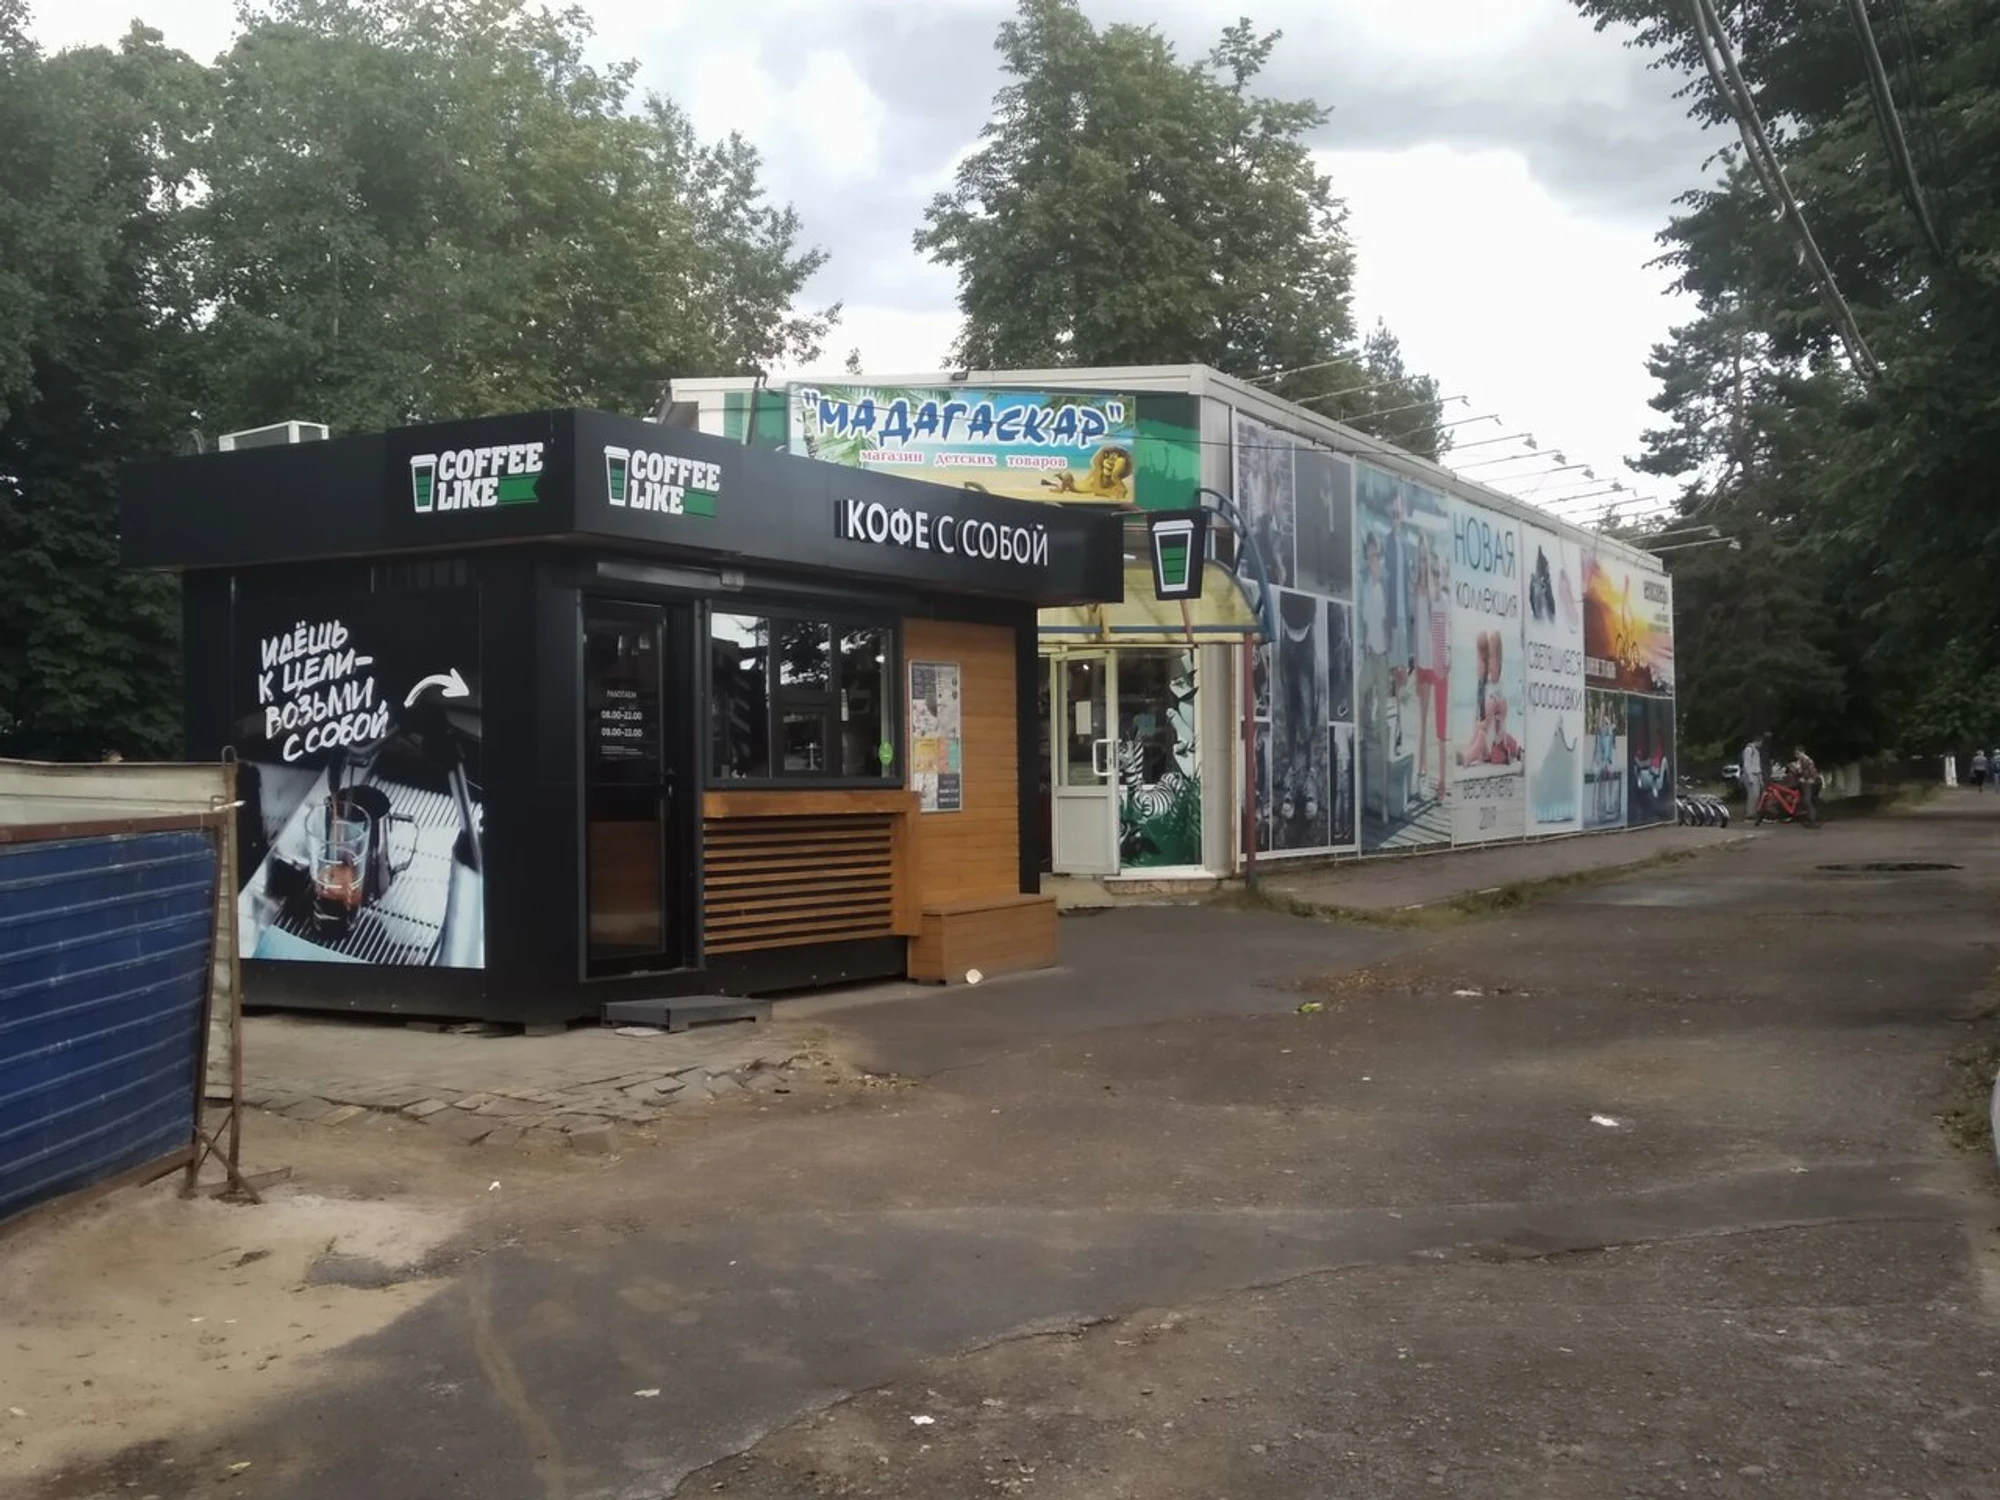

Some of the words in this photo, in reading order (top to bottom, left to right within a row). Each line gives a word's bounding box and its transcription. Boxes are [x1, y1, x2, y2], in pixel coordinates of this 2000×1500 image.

[803, 390, 1123, 447] "МАДАГАСКАР"
[438, 442, 543, 481] COFFEE
[630, 450, 721, 491] COFFEE
[861, 449, 923, 463] магазин
[935, 453, 995, 466] детских
[1007, 455, 1067, 469] товаров
[437, 477, 499, 511] LIKE
[630, 479, 684, 515] LIKE
[848, 499, 930, 549] КОФЕ
[937, 515, 955, 553] С
[962, 519, 1048, 567] СОБОЙ
[1453, 512, 1516, 580] НОВАЯ
[261, 618, 348, 671] ИДЁШЬ
[258, 670, 275, 704] К
[265, 676, 375, 739] ВОЗЬМИ
[1527, 681, 1583, 713] КРОССОВКИ
[305, 699, 389, 753] СОБОЙ
